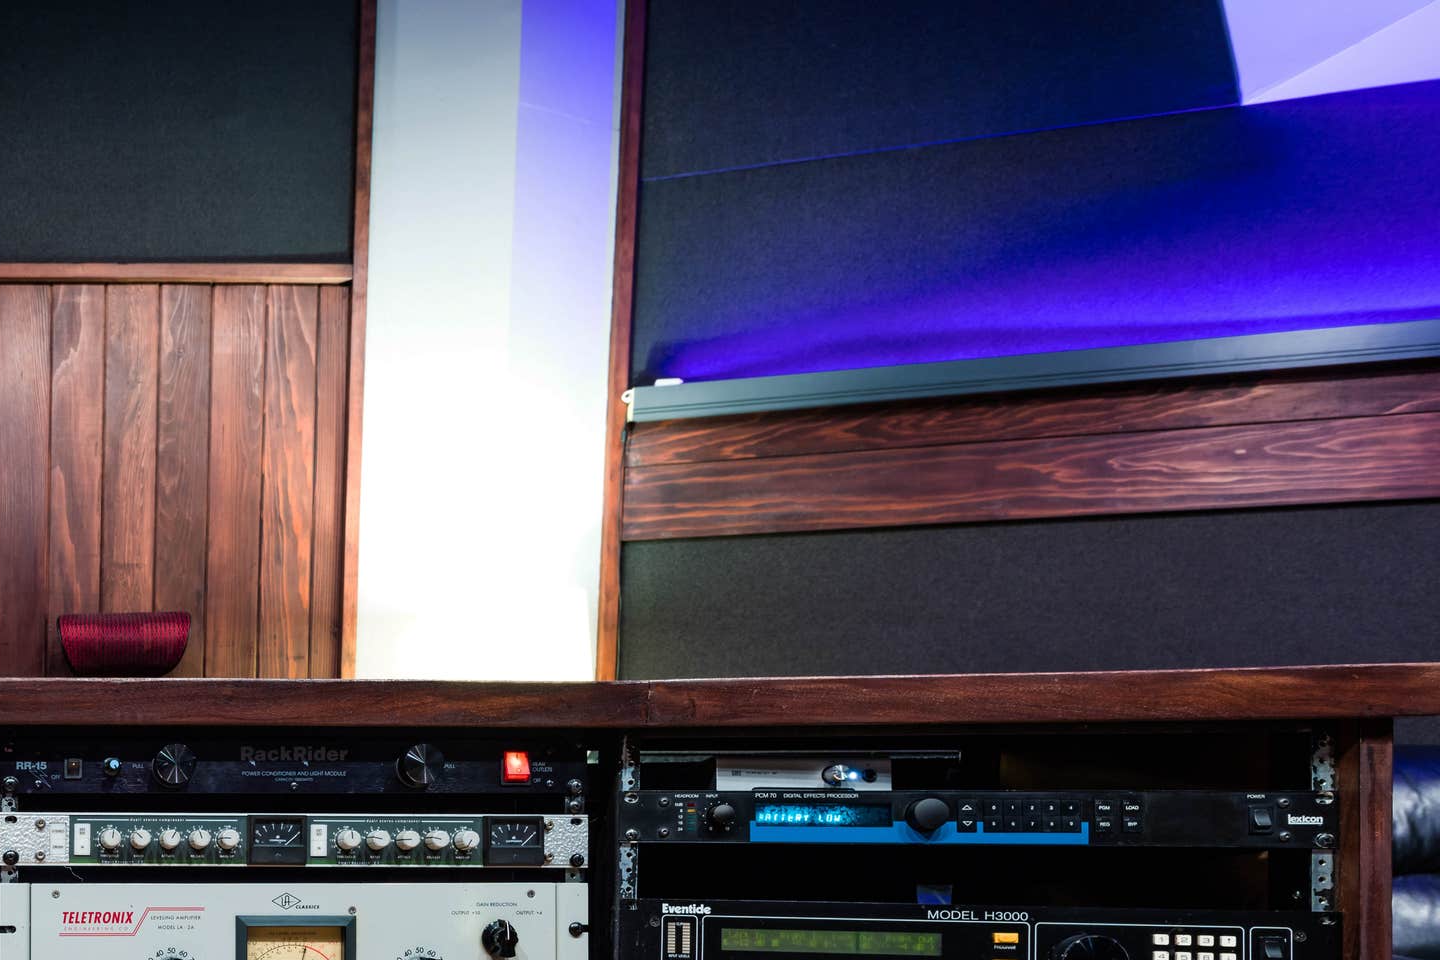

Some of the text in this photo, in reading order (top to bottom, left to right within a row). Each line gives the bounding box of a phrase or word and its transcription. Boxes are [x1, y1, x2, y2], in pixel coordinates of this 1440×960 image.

[16, 761, 47, 770] RR-15
[662, 903, 712, 915] Eventide
[62, 911, 134, 924] TELETRONIX
[927, 910, 1029, 921] MODEL H3000
